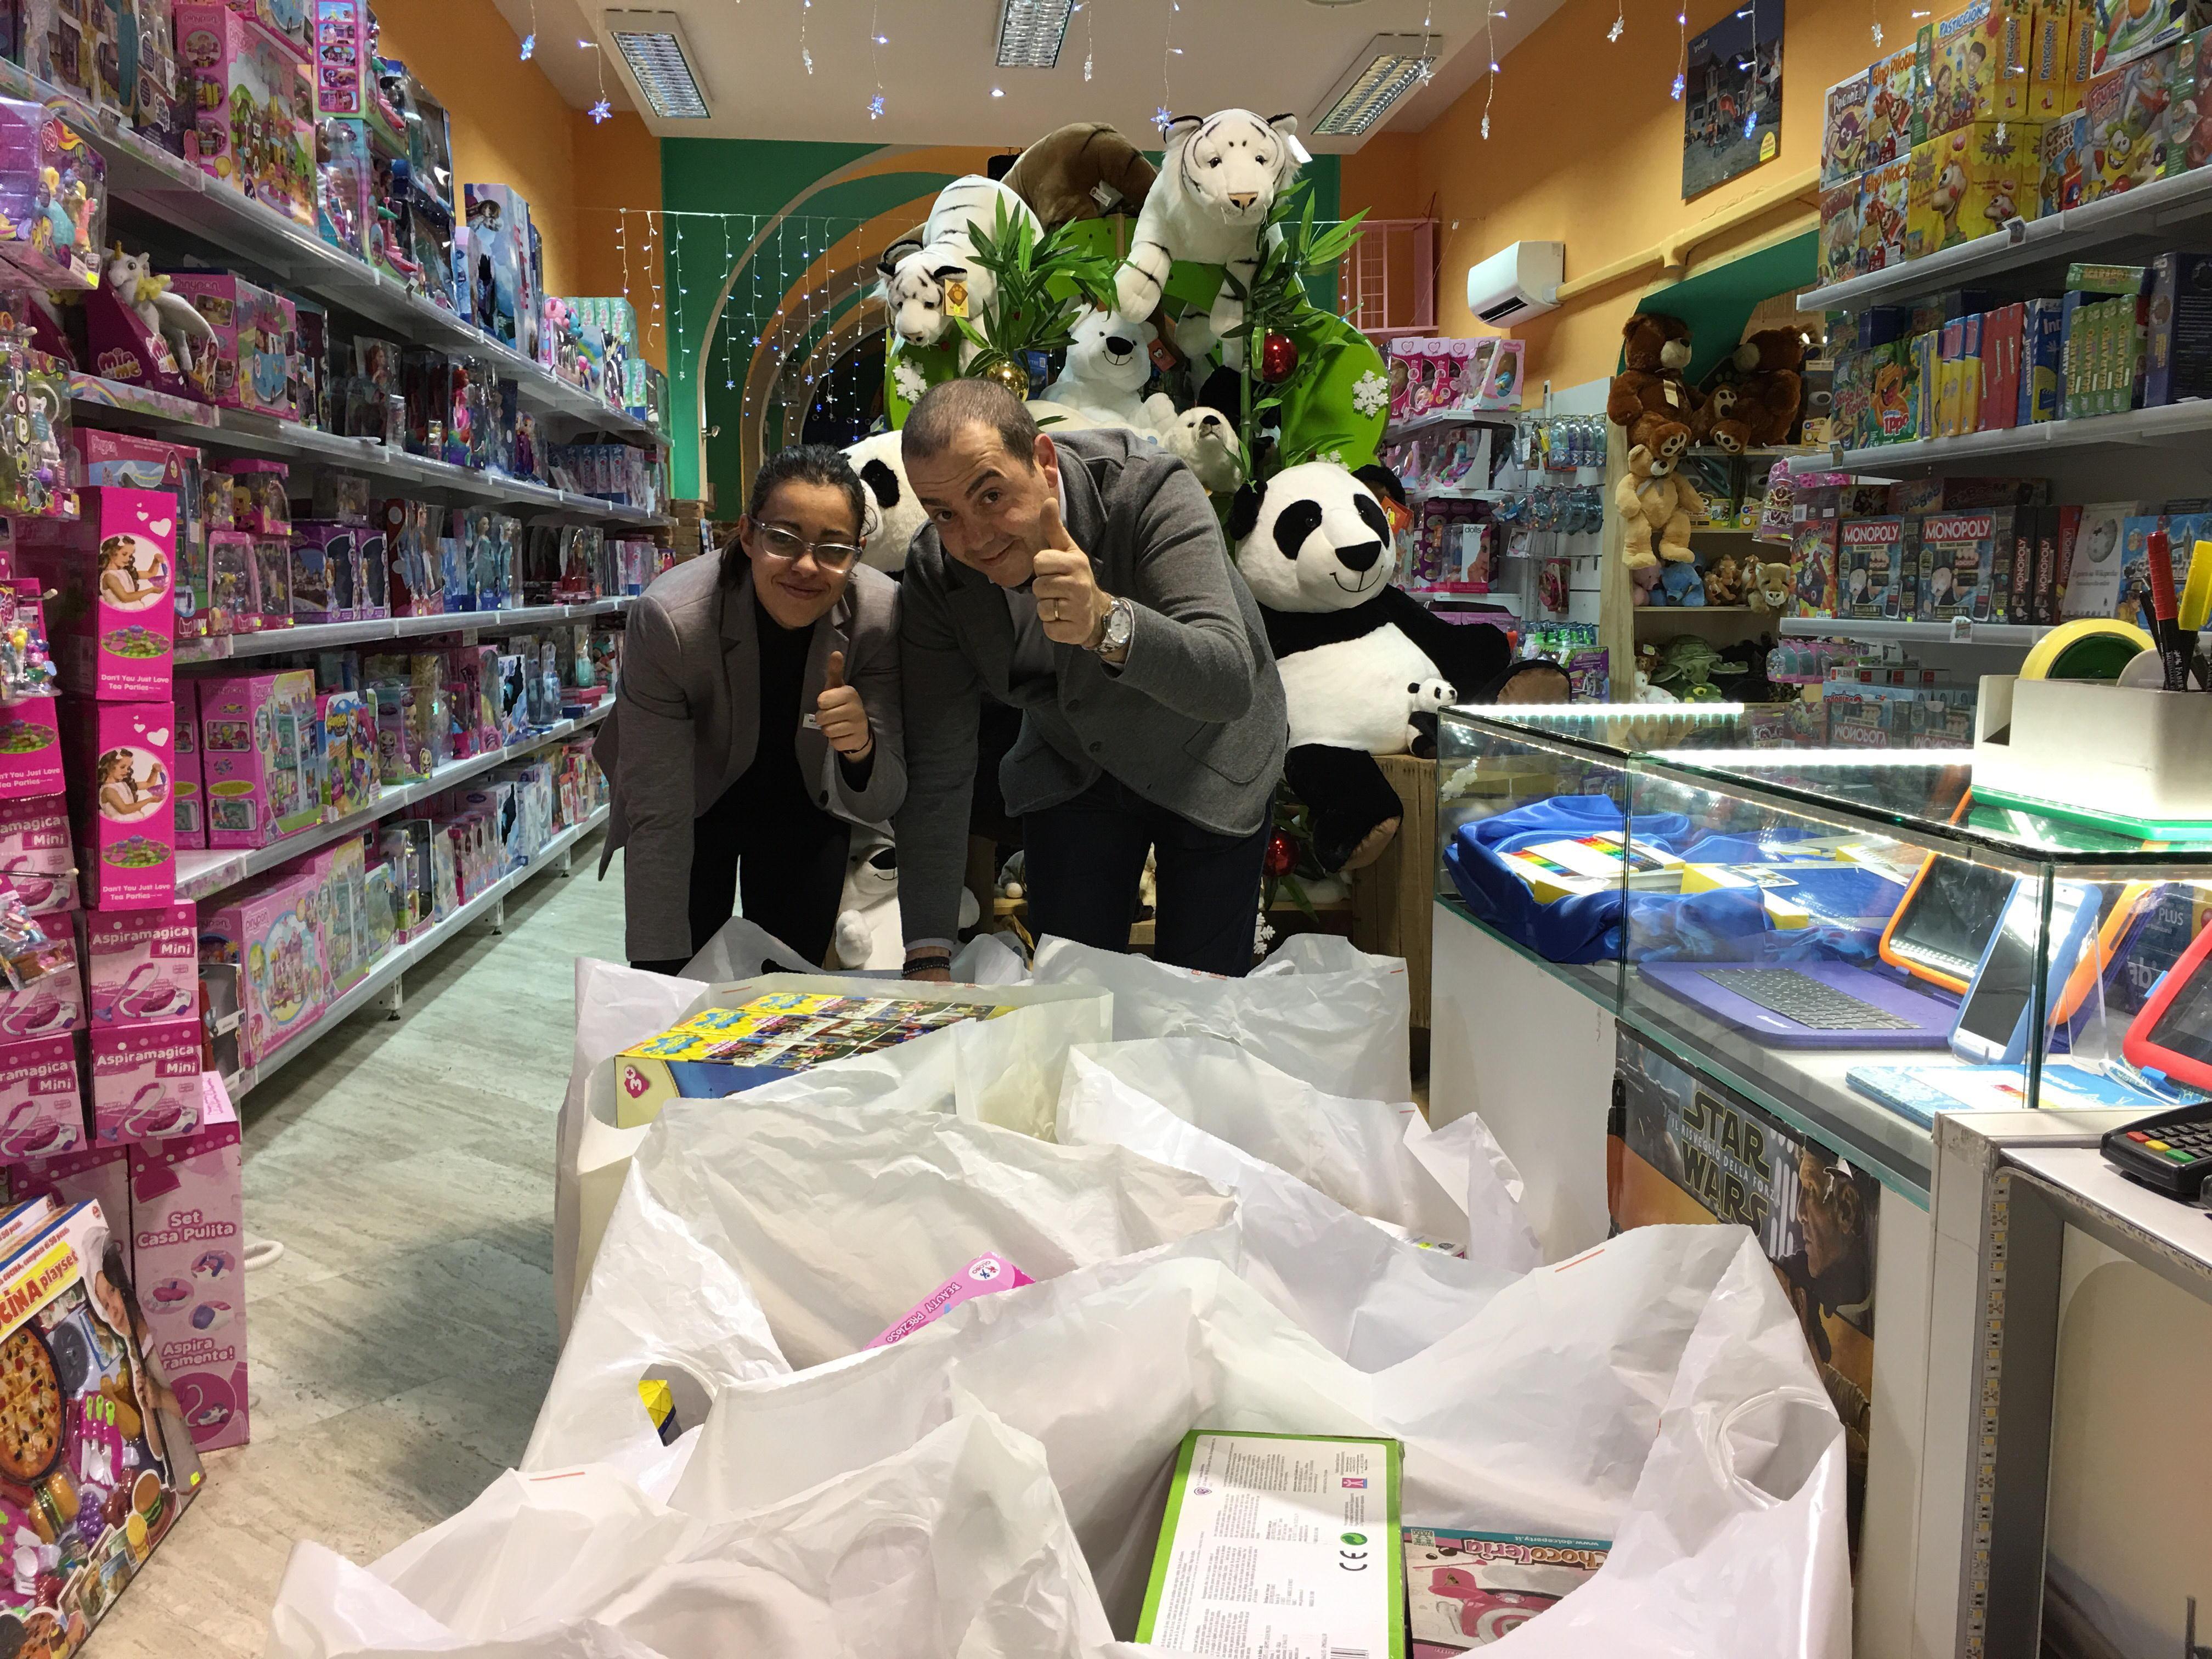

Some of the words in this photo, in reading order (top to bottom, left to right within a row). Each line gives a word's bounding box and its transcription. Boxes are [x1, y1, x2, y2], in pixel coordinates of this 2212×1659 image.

[1844, 525, 1899, 543] MONOPOLY
[1925, 520, 1990, 539] MONOPOLY
[2015, 539, 2026, 592] MONOPOLY
[2039, 540, 2051, 592] MONOPOLY
[0, 817, 60, 834] amagica
[33, 834, 64, 845] Mini
[2158, 907, 2184, 926] PLUS
[92, 927, 189, 945] Aspiramagica
[161, 944, 191, 955] Mini
[97, 1046, 194, 1066] Aspiramagica
[0, 1062, 69, 1082] ramagica
[167, 1062, 196, 1074] Mini
[40, 1078, 72, 1091] Mini
[1682, 1091, 1771, 1182] STAR
[1672, 1118, 1679, 1131] IL
[1681, 1125, 1720, 1161] RISVEGLIO
[1723, 1155, 1749, 1182] DELLA
[1753, 1176, 1781, 1207] FORZA
[1681, 1138, 1769, 1238] WARS
[171, 1211, 200, 1226] Set
[138, 1231, 178, 1246] Casa
[184, 1224, 234, 1241] Pulita
[40, 1248, 79, 1291] playset
[972, 1261, 991, 1274] GLOBO
[926, 1282, 962, 1313] BEAUTY
[886, 1311, 926, 1343] PREZIOSO
[163, 1339, 212, 1356] Aspira
[163, 1347, 234, 1369] ramente!
[1514, 1536, 1599, 1546] www.dolceparty.it
